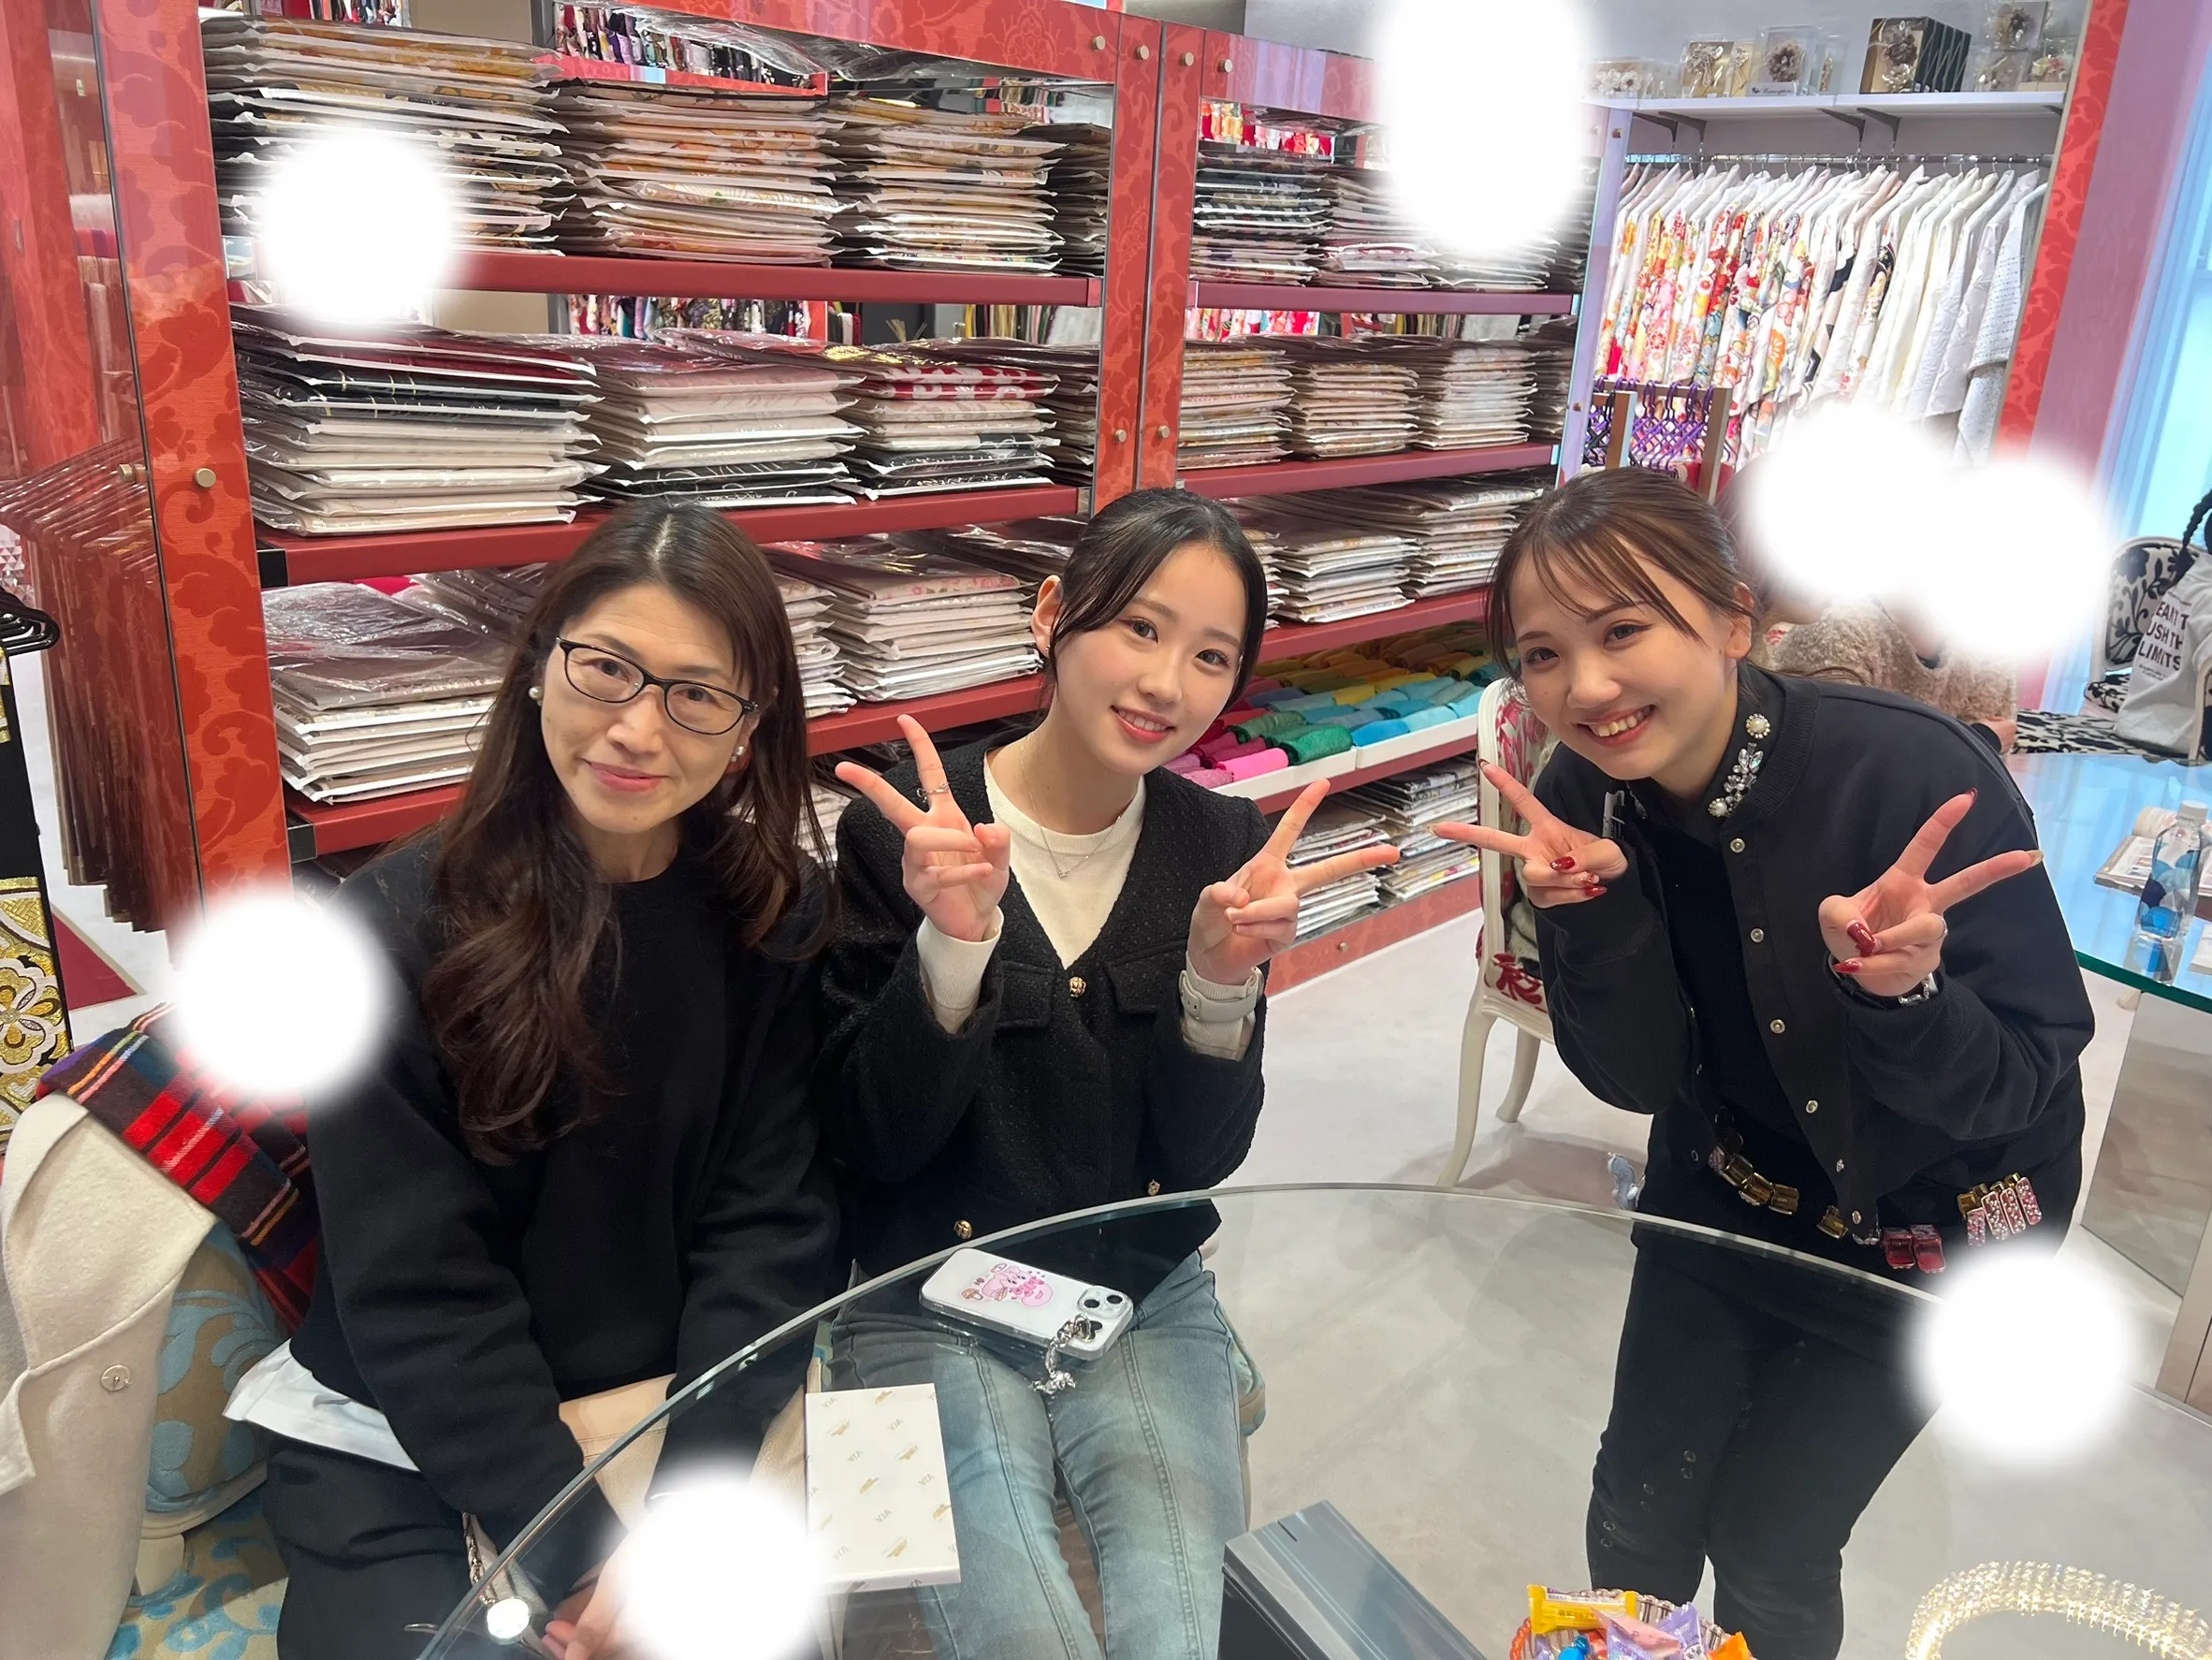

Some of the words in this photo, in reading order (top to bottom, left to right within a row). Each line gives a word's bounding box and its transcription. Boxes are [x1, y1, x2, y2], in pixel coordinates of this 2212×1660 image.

[2155, 602, 2178, 626] EANT
[2180, 613, 2190, 630] T
[2146, 621, 2170, 644] USH
[2138, 640, 2182, 671] LIMITS
